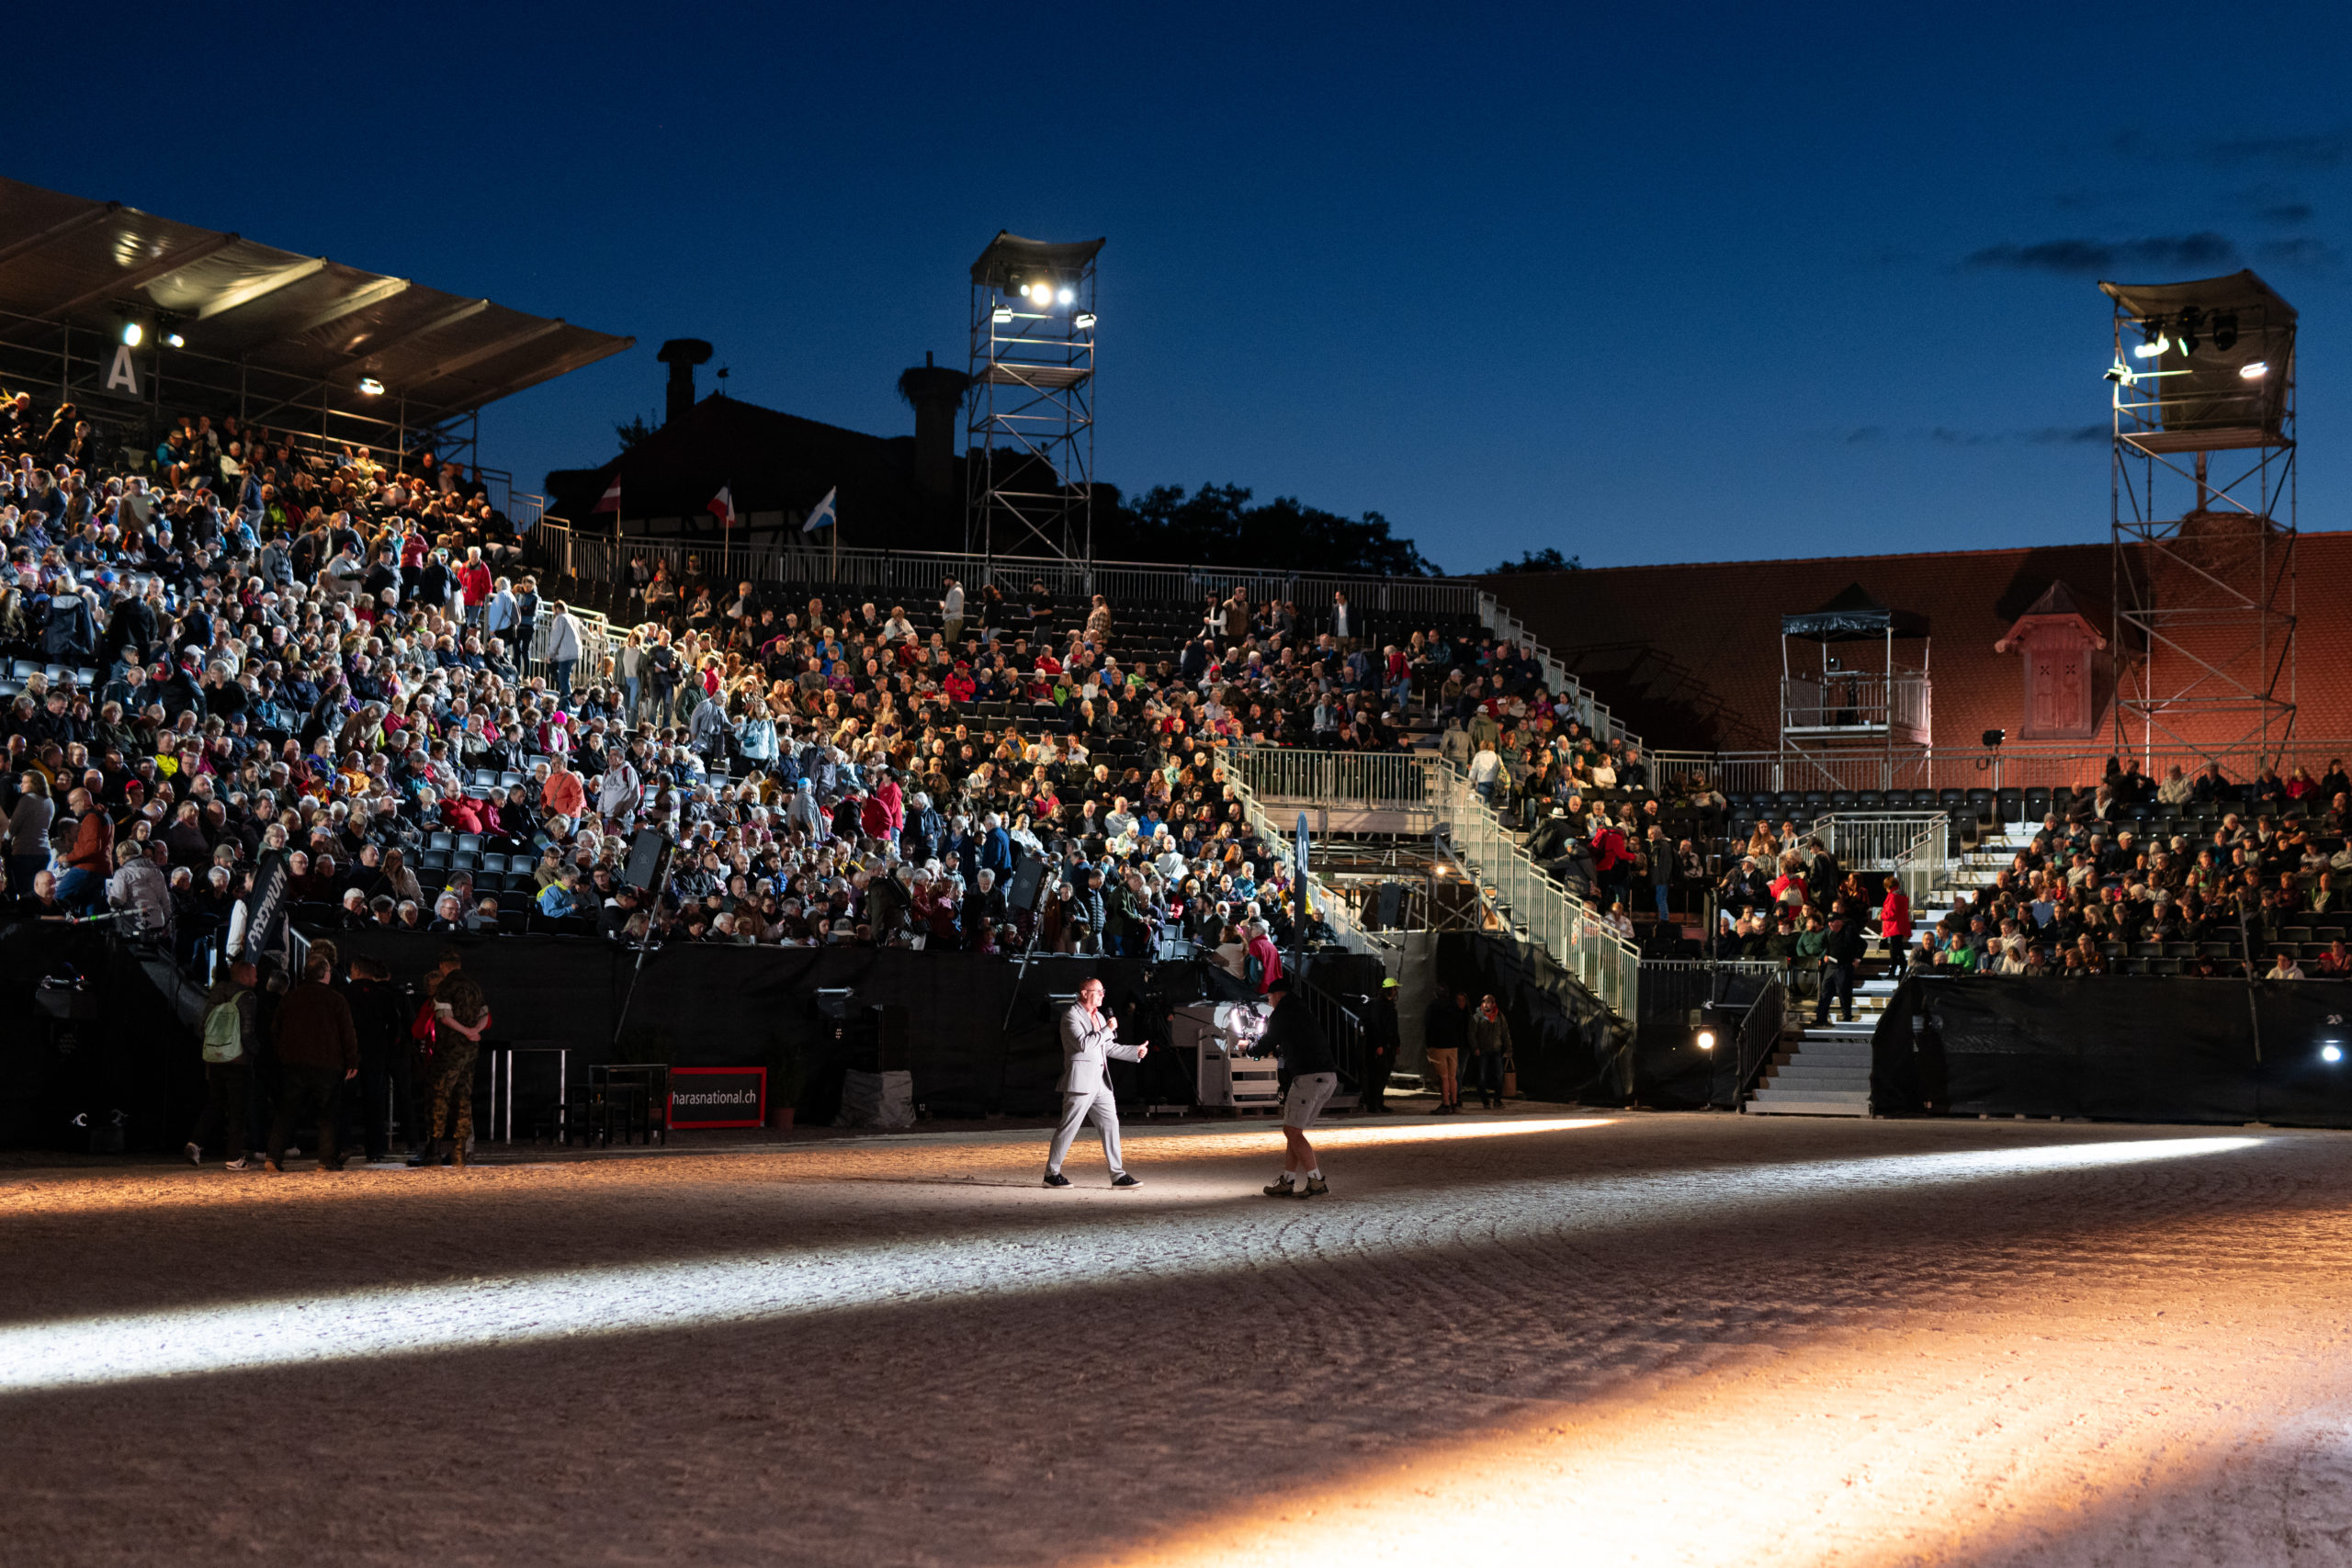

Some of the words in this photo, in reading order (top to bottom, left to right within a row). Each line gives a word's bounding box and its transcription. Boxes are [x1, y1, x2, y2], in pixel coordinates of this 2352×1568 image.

[107, 344, 138, 394] A
[247, 863, 288, 952] PREMIUM
[672, 1089, 756, 1105] harasnational.ch
